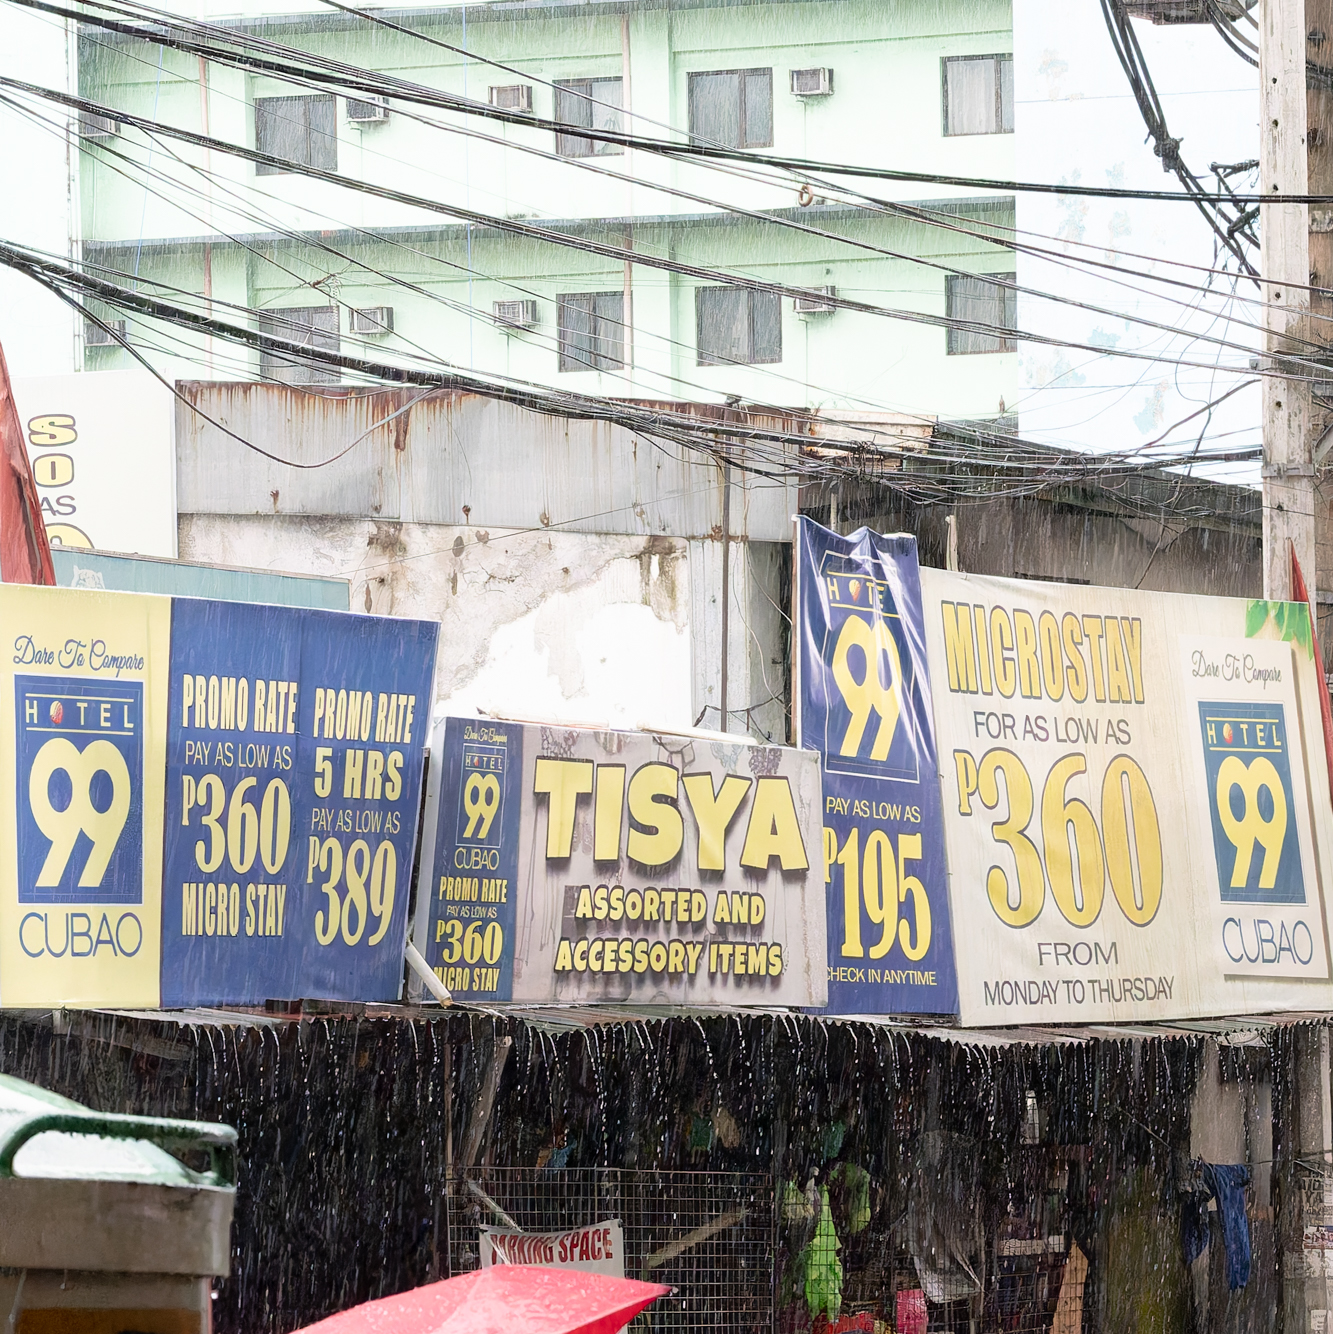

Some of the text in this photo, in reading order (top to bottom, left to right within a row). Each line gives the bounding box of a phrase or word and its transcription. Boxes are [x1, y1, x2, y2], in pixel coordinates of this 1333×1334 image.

[13, 634, 144, 678] Dare To Compare
[941, 600, 1145, 705] MICROSTAY
[1191, 650, 1282, 690] Dare To Compare
[182, 674, 298, 734] PROMO RATE
[832, 614, 901, 762] 99
[313, 688, 416, 744] PROMO RATE
[974, 711, 1131, 746] FOR AS LOW AS
[185, 740, 293, 771] PAY AS LOW AS
[314, 747, 404, 801] 5 HRS
[29, 737, 131, 888] 99
[181, 773, 291, 875] P360
[310, 807, 401, 835] PAY AS LOW AS
[463, 772, 501, 839] 99
[533, 755, 810, 873] TISYA
[826, 797, 921, 824] PAY AS LOW AS
[1216, 755, 1287, 889] 99
[454, 848, 500, 870] CUBAO
[954, 747, 1163, 929] P360
[181, 882, 287, 937] MICRO STAY
[307, 836, 397, 947] P389
[439, 876, 508, 903] PROMO RATE
[446, 904, 498, 919] PAY AS LOW AS
[575, 885, 766, 928] ASSORTED AND
[19, 912, 142, 958] CUBAO
[436, 920, 503, 964] P360
[1037, 941, 1118, 966] FROM
[1222, 917, 1313, 966] CUBAO
[434, 966, 501, 992] MICRO STAY
[554, 938, 783, 978] ACCESSORY ITEMS
[826, 967, 937, 986] CHECK IN ANYTIME
[984, 975, 1175, 1007] MONDAY TO THURSDAY
[558, 1228, 613, 1263] SPACE
